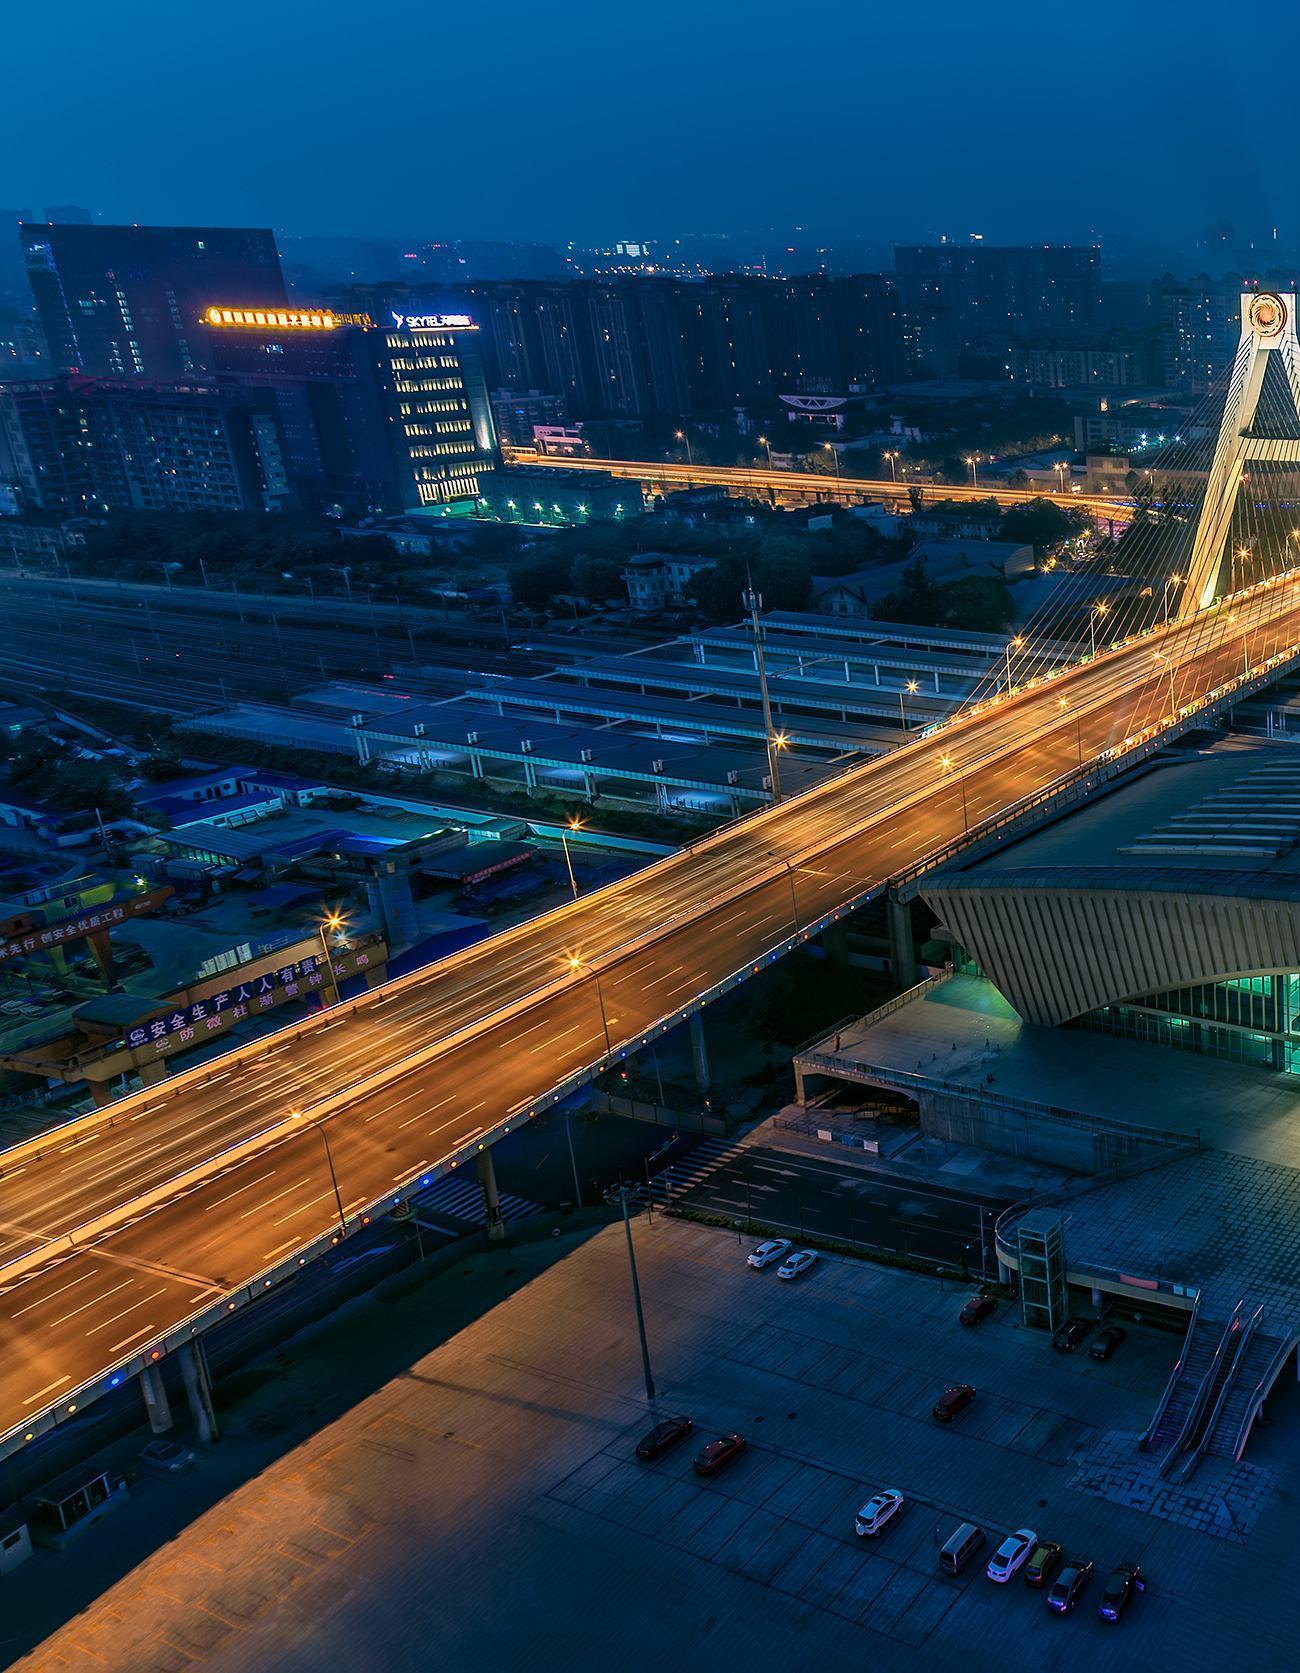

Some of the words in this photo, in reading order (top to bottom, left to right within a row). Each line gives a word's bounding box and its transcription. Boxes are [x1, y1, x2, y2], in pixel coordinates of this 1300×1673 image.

[151, 957, 316, 1038] 安全生产人人有责
